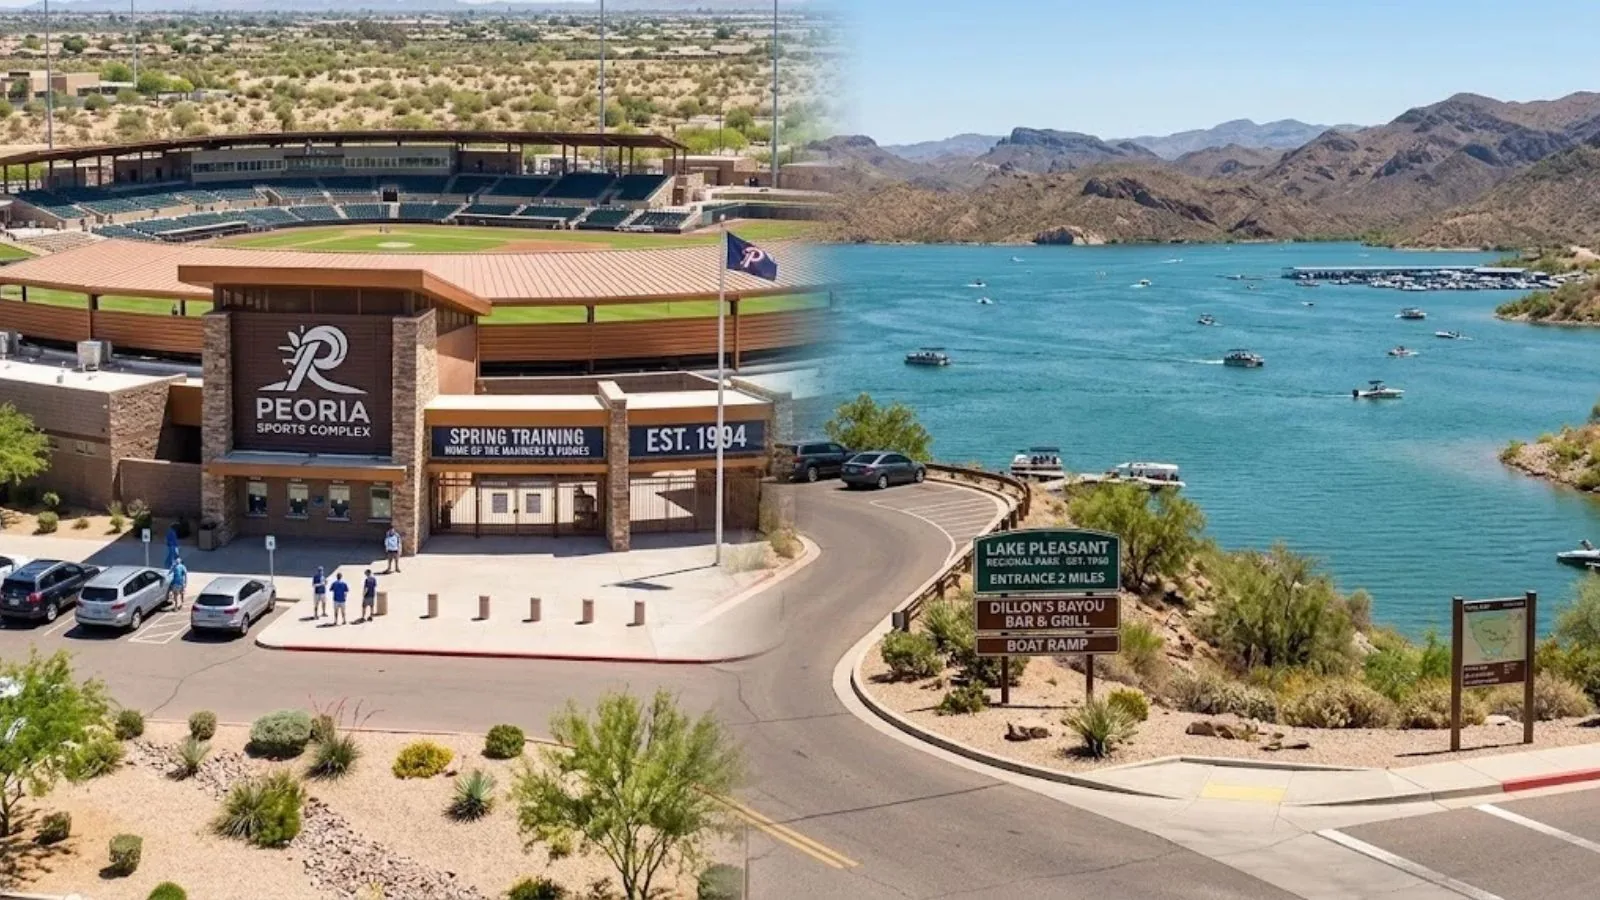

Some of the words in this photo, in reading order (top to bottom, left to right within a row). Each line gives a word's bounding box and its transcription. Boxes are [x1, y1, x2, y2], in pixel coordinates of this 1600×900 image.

[256, 397, 371, 424] PEORIA
[256, 422, 306, 435] SPORTS
[309, 424, 371, 437] COMPLEX
[450, 428, 507, 445] SPRING
[511, 428, 584, 445] TRAINING
[646, 428, 690, 453] EST.
[696, 424, 747, 450] 1994
[444, 445, 470, 456] HOME
[986, 542, 1026, 556] LAKE
[1029, 541, 1109, 555] PLEASANT
[986, 557, 1034, 567] REGIONAL
[1034, 556, 1060, 566] PARK
[990, 573, 1056, 585] ENTRANCE
[1058, 573, 1066, 584] 2
[1068, 572, 1105, 584] MILES
[990, 601, 1054, 614] DILLON'S
[1057, 600, 1105, 612] BAYOU
[1006, 615, 1034, 628] BAR
[1037, 615, 1048, 627] &
[1051, 614, 1090, 627] GRILL
[1007, 640, 1044, 652] BOAT
[1047, 639, 1088, 651] RAMP
